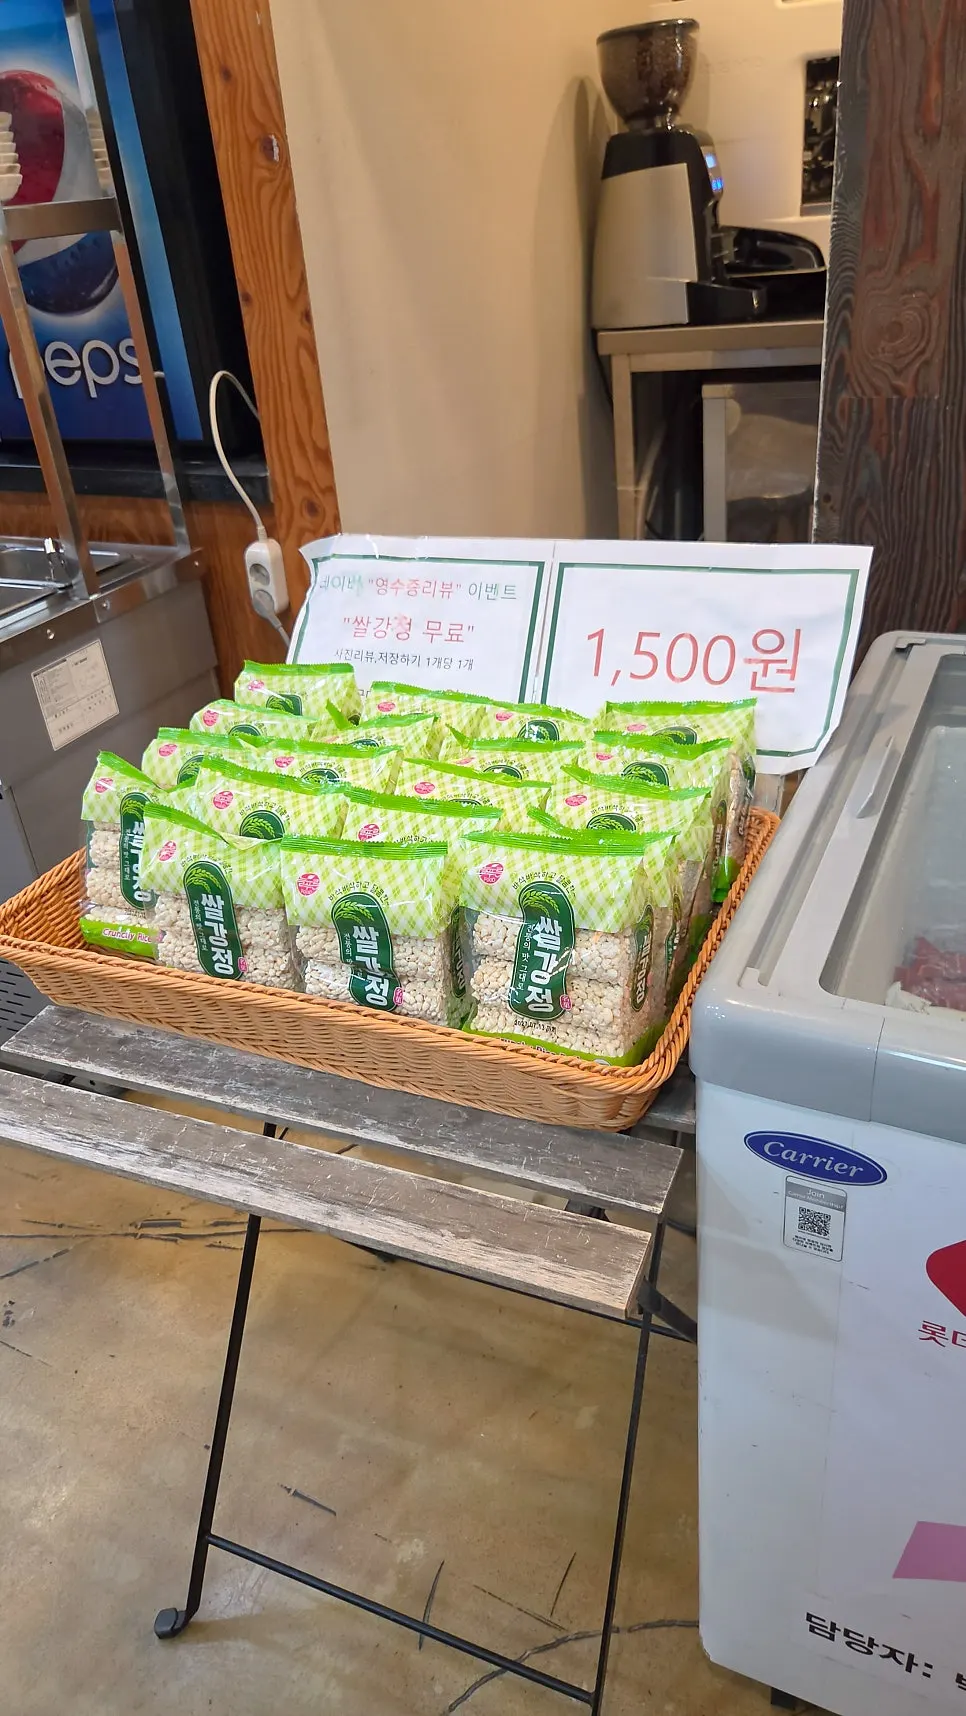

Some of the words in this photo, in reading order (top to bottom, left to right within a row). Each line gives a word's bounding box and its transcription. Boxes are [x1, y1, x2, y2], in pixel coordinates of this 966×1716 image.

[368, 577, 462, 599] "영수증리뷰"
[468, 583, 517, 600] 이벤트
[423, 620, 475, 643] 무료"
[335, 649, 422, 668] 사진리뷰,저장하기
[426, 657, 453, 670] 1개당
[458, 658, 474, 671] 1개
[586, 628, 801, 693] 1,500원
[200, 893, 235, 975] 쌀강정
[525, 916, 563, 1013] 쌀강정
[763, 1141, 864, 1178] Carrier
[807, 1188, 825, 1199] Join
[805, 1612, 933, 1678] 담당자:
